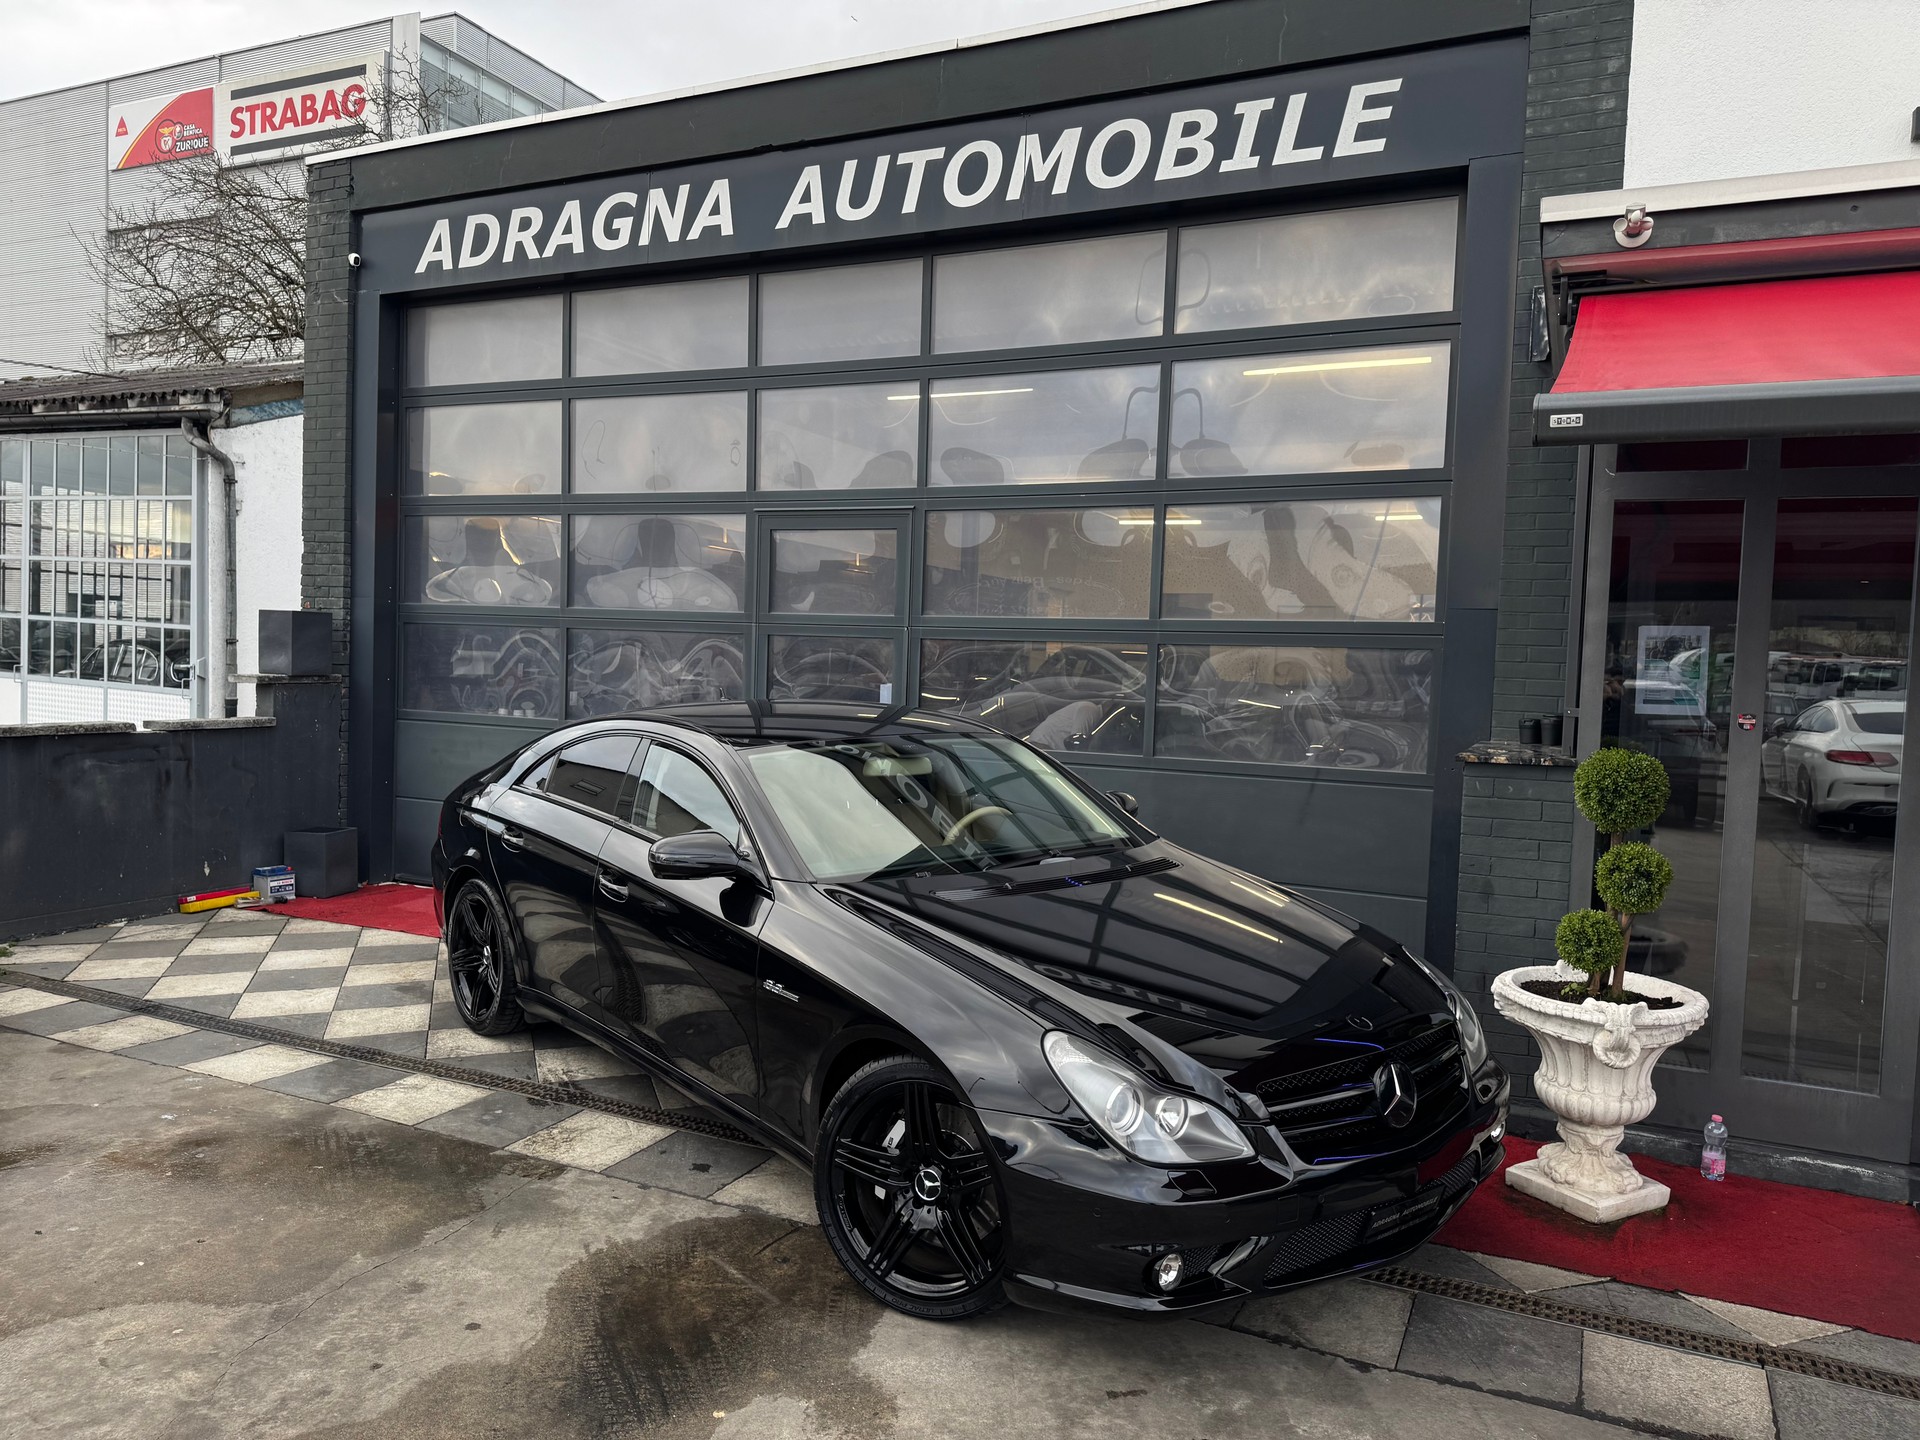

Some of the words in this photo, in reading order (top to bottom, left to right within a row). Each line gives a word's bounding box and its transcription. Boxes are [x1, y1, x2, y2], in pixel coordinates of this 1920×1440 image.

[229, 83, 367, 139] STRABAG
[175, 136, 209, 152] ZURIQUE
[415, 178, 734, 274] ADRAGNA
[775, 77, 1403, 230] AUTOMOBILE
